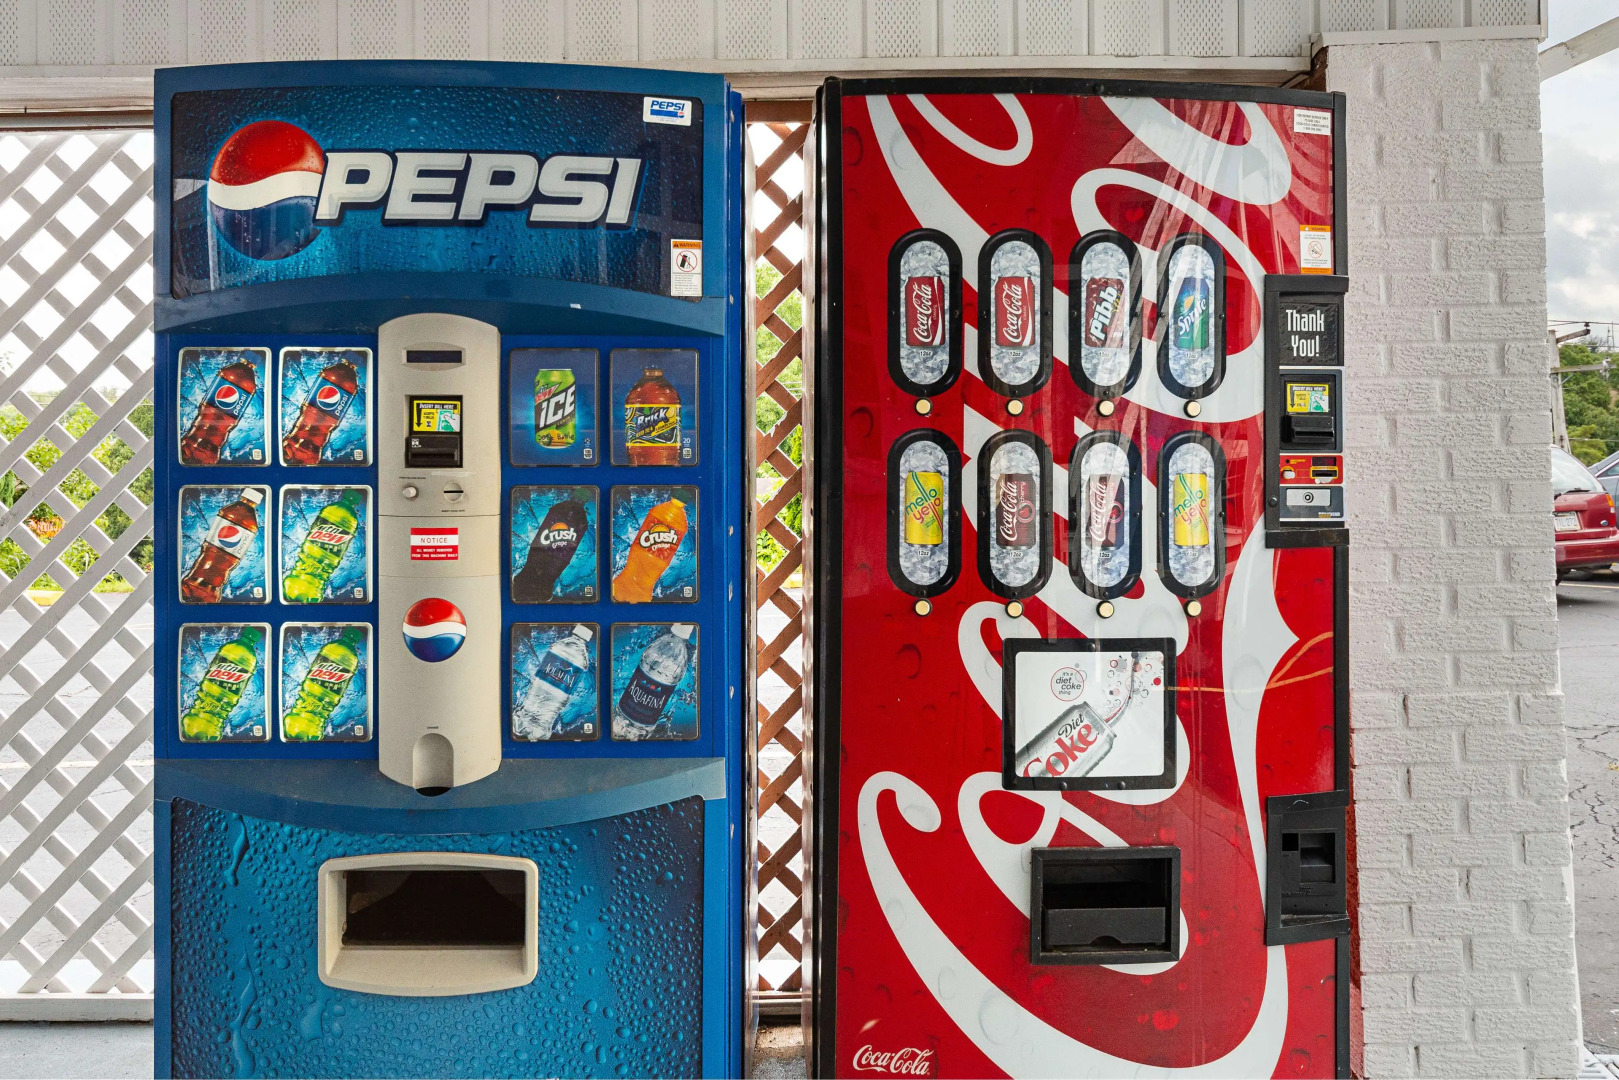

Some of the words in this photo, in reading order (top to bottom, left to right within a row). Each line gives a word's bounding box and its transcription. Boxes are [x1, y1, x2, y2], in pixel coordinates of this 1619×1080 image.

[651, 100, 685, 111] PEPSI
[315, 151, 642, 225] PEPSI
[913, 282, 932, 342] Coca-Cola
[1003, 281, 1022, 342] Coca-Cola
[1089, 286, 1118, 340] Pibb
[1178, 299, 1206, 335] Sprite
[1286, 310, 1324, 331] Thank
[1291, 335, 1319, 357] You!
[234, 394, 247, 415] pepsi
[334, 394, 348, 416] pepsi
[540, 384, 575, 428] ICE
[637, 408, 667, 426] Brisk
[905, 488, 937, 516] mello
[913, 497, 941, 524] yello
[1000, 480, 1017, 541] Coca-Cola
[1174, 490, 1203, 518] mello
[1181, 499, 1207, 525] yello
[541, 527, 577, 545] Crush
[640, 530, 677, 547] Crush
[543, 663, 575, 688] AQUAFINA
[629, 679, 665, 709] AQUAFINA
[1058, 713, 1085, 738] Diet
[1023, 723, 1098, 777] Coke
[853, 1045, 935, 1075] Coca-Cola
